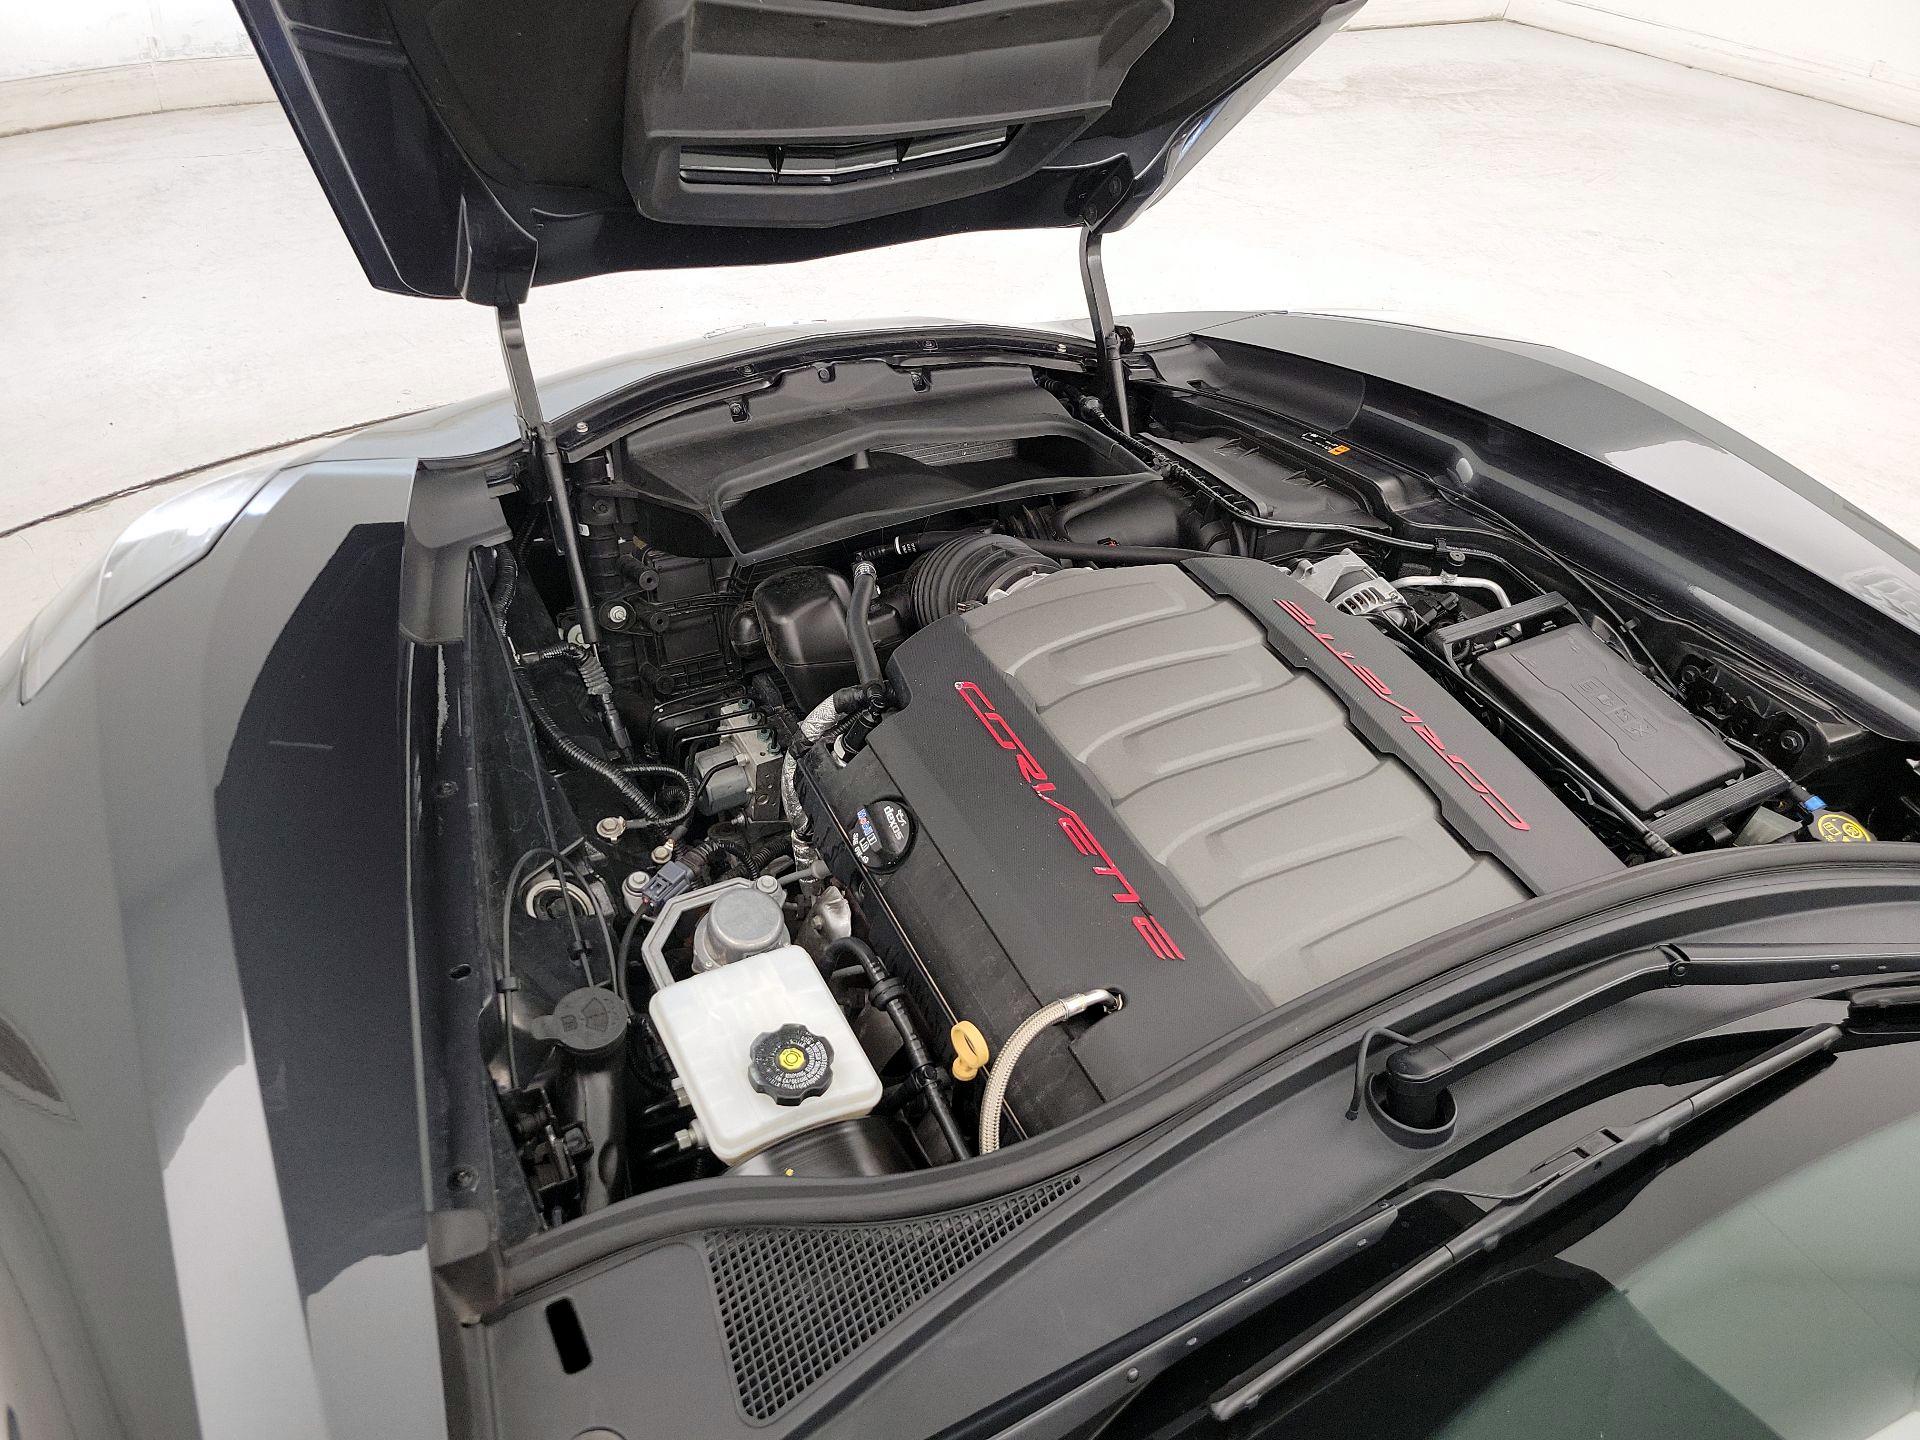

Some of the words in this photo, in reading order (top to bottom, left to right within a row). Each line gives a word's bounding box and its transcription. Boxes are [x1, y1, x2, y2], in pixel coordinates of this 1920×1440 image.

[884, 806, 904, 840] dexos
[954, 681, 1186, 961] CORVETTE
[1273, 598, 1530, 831] CORVETTE
